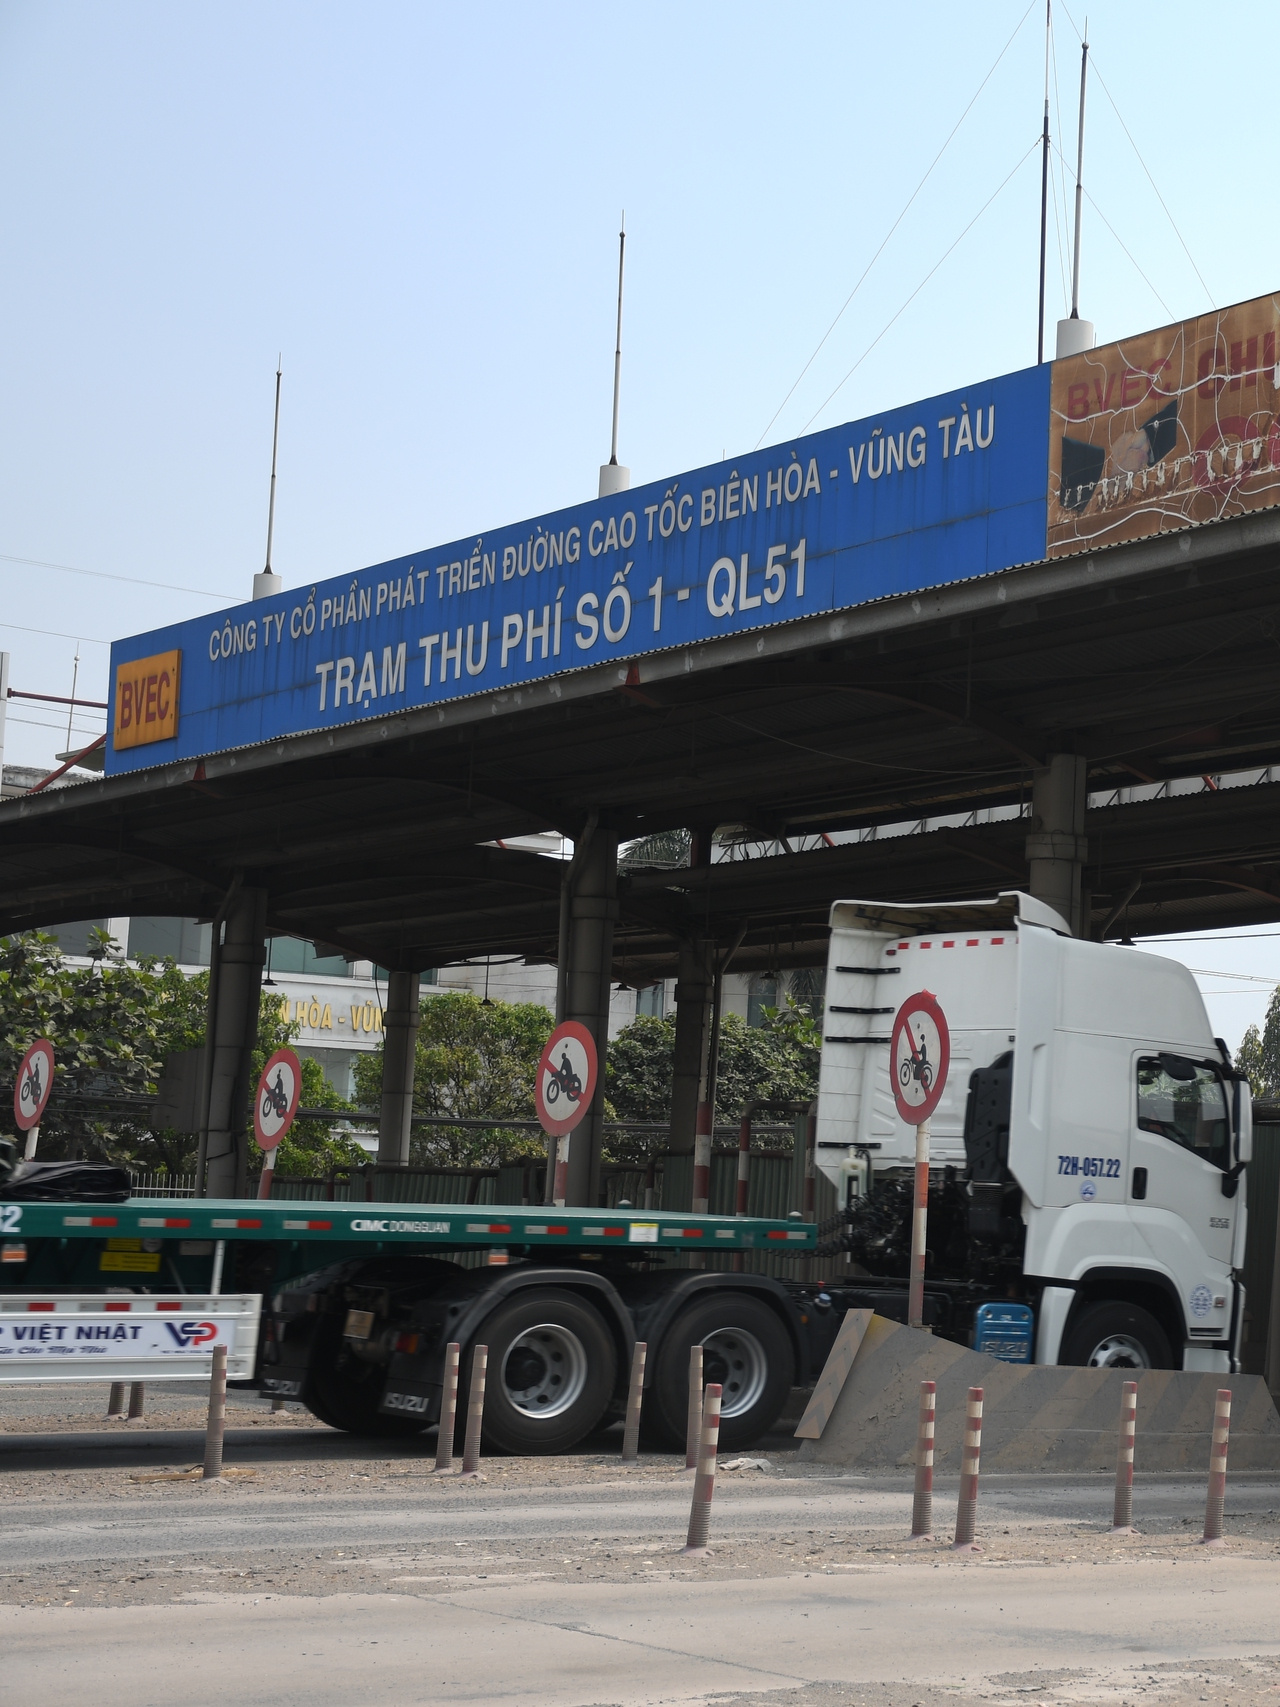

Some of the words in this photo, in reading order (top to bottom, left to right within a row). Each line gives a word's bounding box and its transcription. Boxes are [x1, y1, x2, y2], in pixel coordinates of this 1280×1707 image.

[1067, 358, 1173, 421] BVEC
[209, 619, 257, 662] CÔNG
[263, 611, 286, 647] TY
[290, 586, 317, 640] CỔ
[320, 579, 372, 631] PHẦN
[376, 566, 429, 617] PHÁT
[436, 538, 496, 599] TRIỂN
[502, 525, 581, 582] ĐƯỜNG
[588, 511, 637, 557] CAO
[645, 483, 694, 542] TỐC
[700, 470, 759, 527] BIÊN
[766, 450, 821, 506] HÒA
[848, 427, 927, 484] VŨNG
[938, 403, 995, 459] TÀU
[315, 642, 406, 712] TRẠM
[418, 621, 490, 687] THU
[501, 585, 566, 669] PHÍ
[575, 561, 634, 651] SỐ
[648, 576, 663, 632] 1
[706, 538, 807, 618] QL51
[120, 671, 171, 729] BVEC
[296, 994, 332, 1030] HÒA
[351, 1000, 387, 1033] VŨN
[1057, 1155, 1121, 1178] 72H-057.22
[350, 1219, 389, 1232] CIMC
[12, 1323, 68, 1343] VIỆT
[75, 1322, 143, 1343] NHẬT
[383, 1391, 430, 1413] ISUZU
